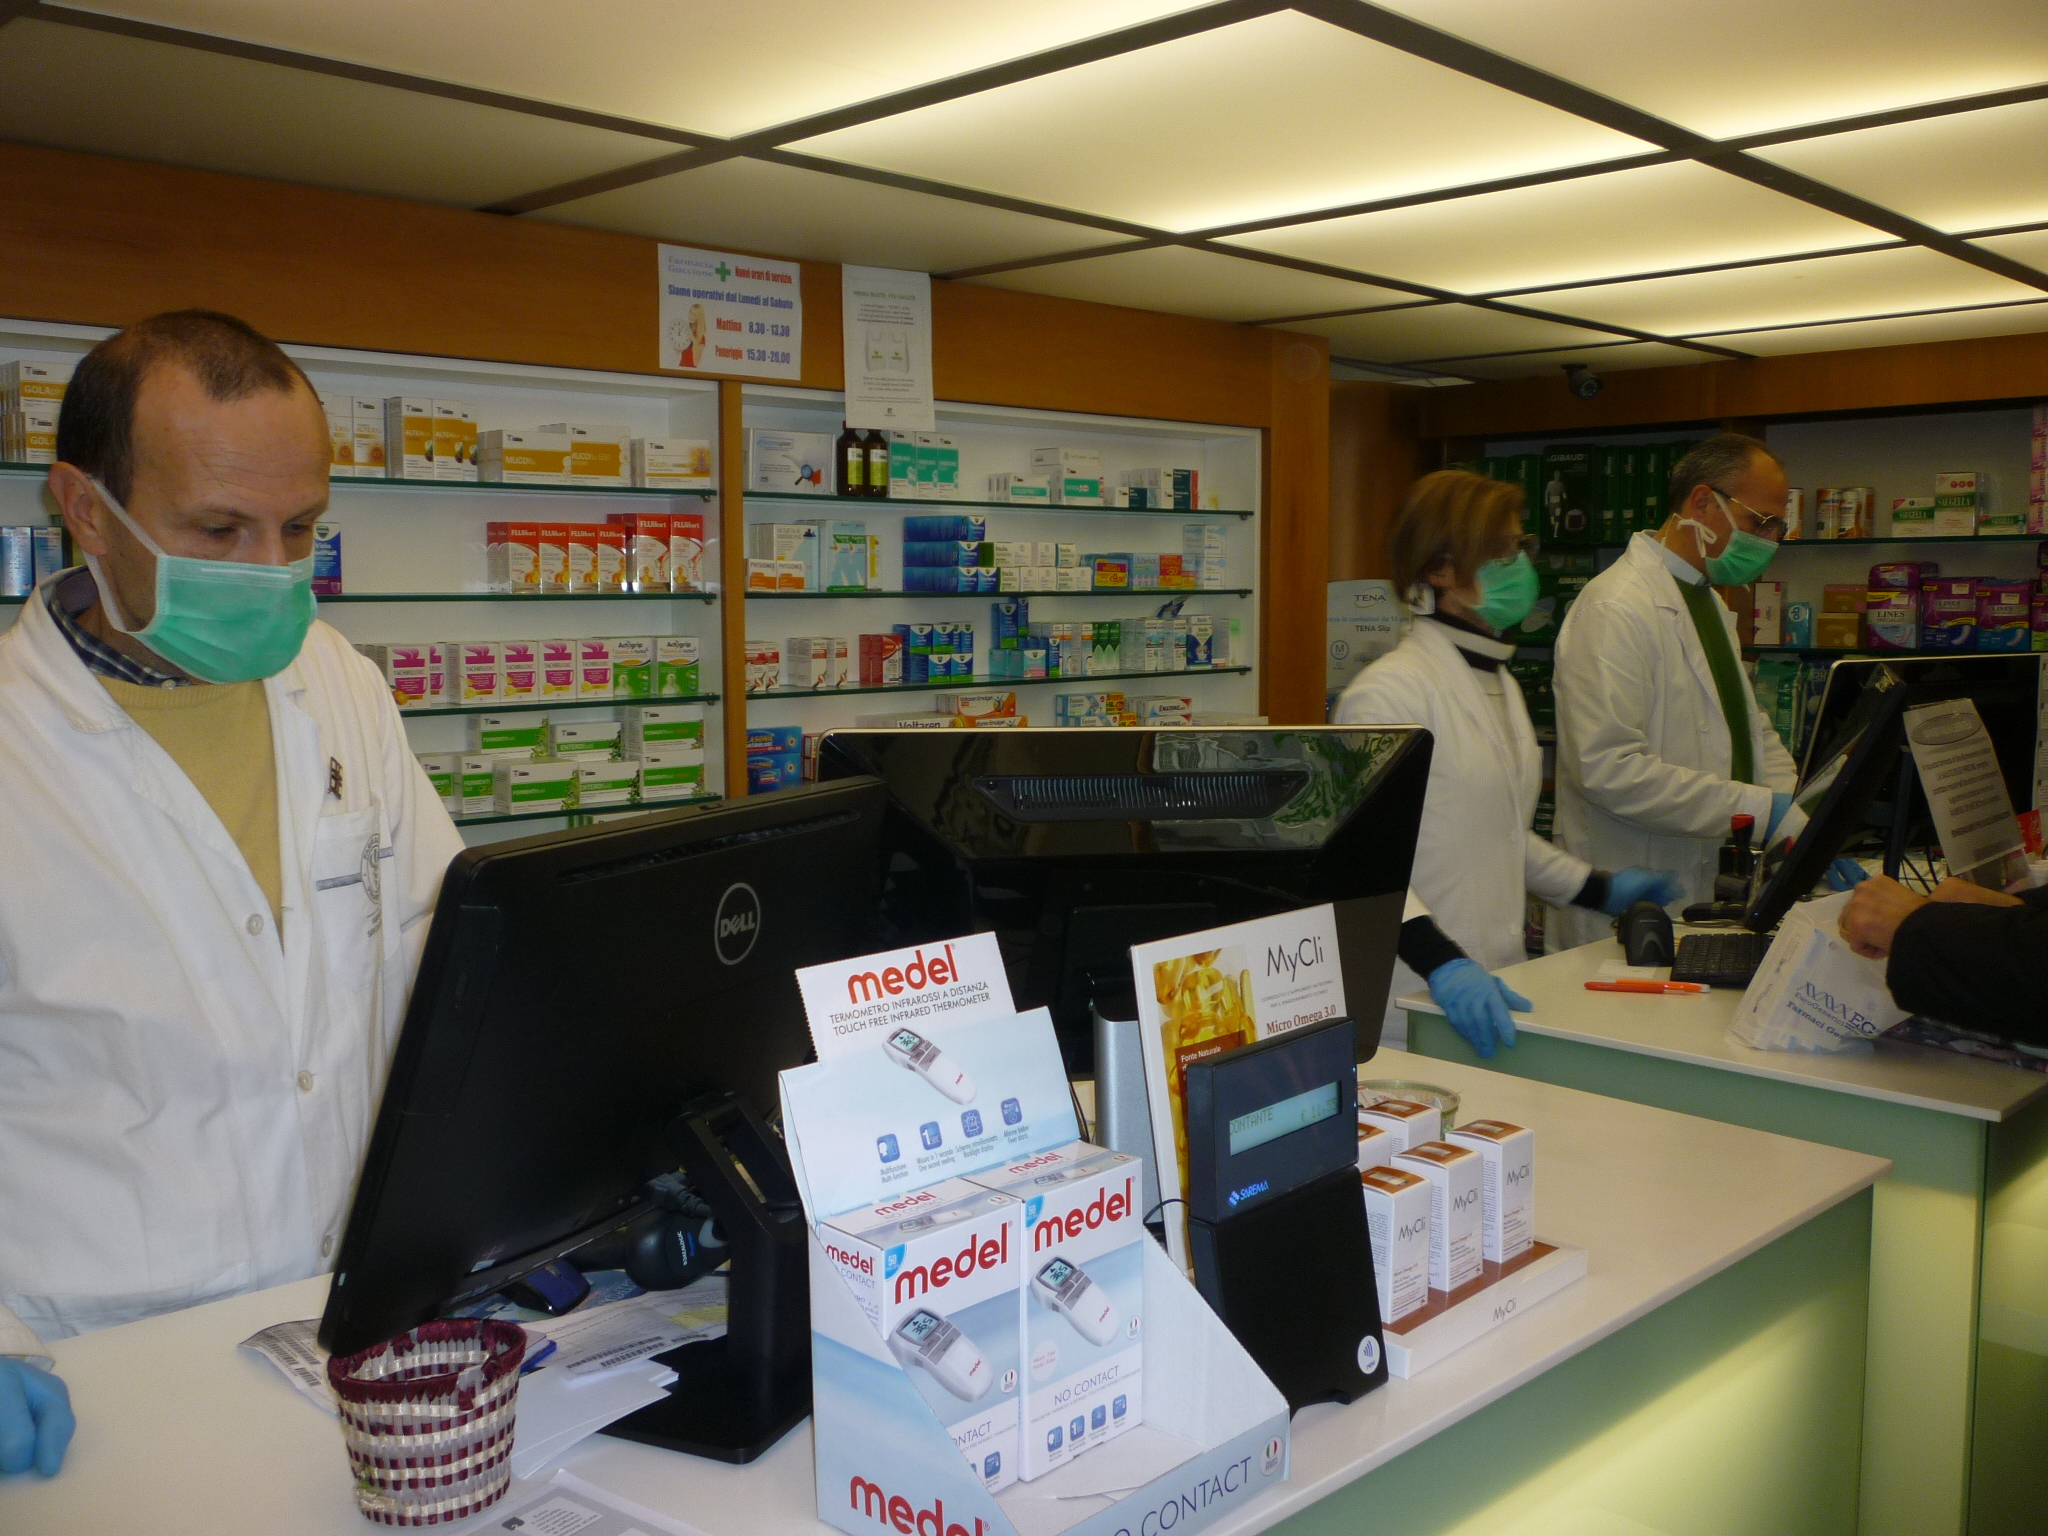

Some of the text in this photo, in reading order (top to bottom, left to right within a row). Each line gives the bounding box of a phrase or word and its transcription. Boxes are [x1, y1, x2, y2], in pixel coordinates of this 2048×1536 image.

[667, 256, 714, 269] Farmacia
[667, 264, 714, 278] Guccione
[751, 268, 764, 280] orari
[771, 272, 792, 284] servizio
[668, 284, 690, 297] Siamo
[692, 288, 724, 301] operativi
[725, 291, 737, 303] dal
[762, 296, 769, 307] al
[770, 296, 794, 309] Sabato
[716, 317, 742, 332] Mattina
[1550, 453, 1584, 461] GIBAUD
[1354, 594, 1386, 602] TENA
[1938, 600, 1961, 608] LINES
[1992, 605, 2014, 613] LINES
[1877, 609, 1906, 618] LINES
[1378, 625, 1391, 634] Slip
[618, 640, 643, 650] Actigrip
[667, 640, 691, 649] Actigrip
[960, 695, 976, 703] Voltaren
[898, 720, 941, 729] Voltaren
[720, 911, 756, 938] DELL
[1267, 936, 1324, 982] MyCli
[847, 943, 959, 1005] medel
[829, 982, 989, 1024] TERMOMETRO INFRAROSSI A DISTANZA
[833, 992, 991, 1036] TOUCH FREE INFRARED THERMOMETER
[1785, 1000, 1826, 1028] Farmaci
[1795, 991, 1846, 1027] EuroGenerici
[1267, 1004, 1337, 1035] Micro Omega 3.0
[1849, 1011, 1876, 1034] EG
[1181, 1045, 1222, 1062] Fonte Naturale
[1009, 1152, 1064, 1174] medel
[1506, 1163, 1530, 1187] MyCli
[1239, 1180, 1269, 1201] SAREMA
[1453, 1188, 1479, 1212] MyCli
[874, 1191, 937, 1216] medel
[1034, 1177, 1133, 1253] medel
[1398, 1217, 1426, 1242] MyCli
[826, 1244, 874, 1276] medel
[888, 1254, 897, 1266] 50
[894, 1221, 1010, 1305] medel
[840, 1267, 876, 1290] CONTACT
[1493, 1297, 1517, 1322] MyCli
[1054, 1389, 1071, 1406] NO
[1073, 1365, 1119, 1396] CONTACT
[1141, 1456, 1252, 1536] CONTACT
